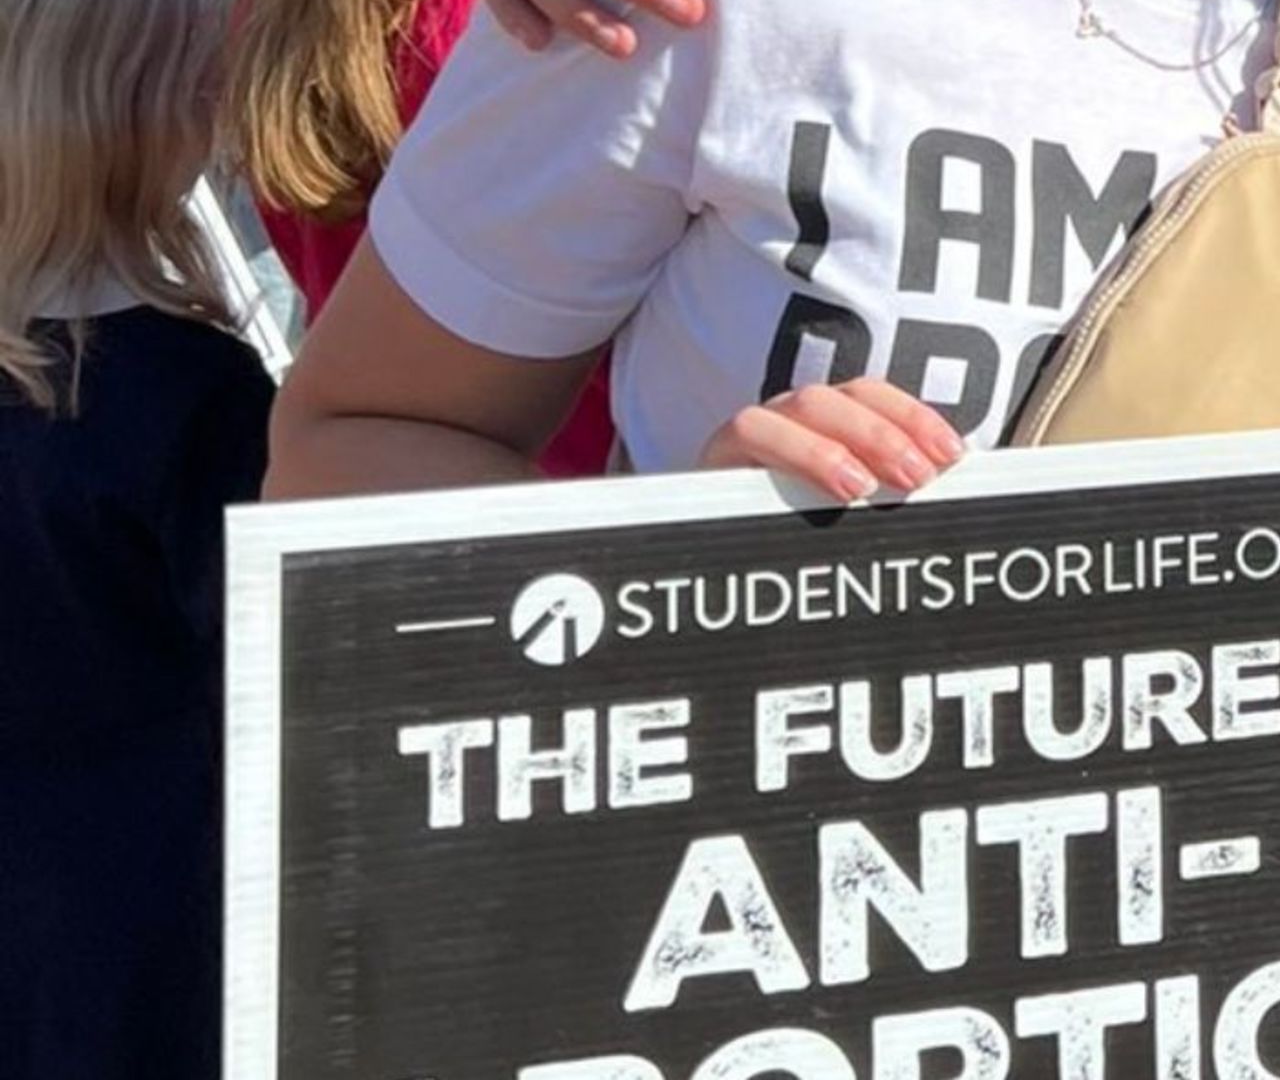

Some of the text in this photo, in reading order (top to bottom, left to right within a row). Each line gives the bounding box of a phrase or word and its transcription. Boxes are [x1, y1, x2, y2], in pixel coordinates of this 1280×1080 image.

[783, 120, 1158, 311] I AM
[397, 696, 694, 830] THE
[622, 784, 1263, 1014] ANTI-
